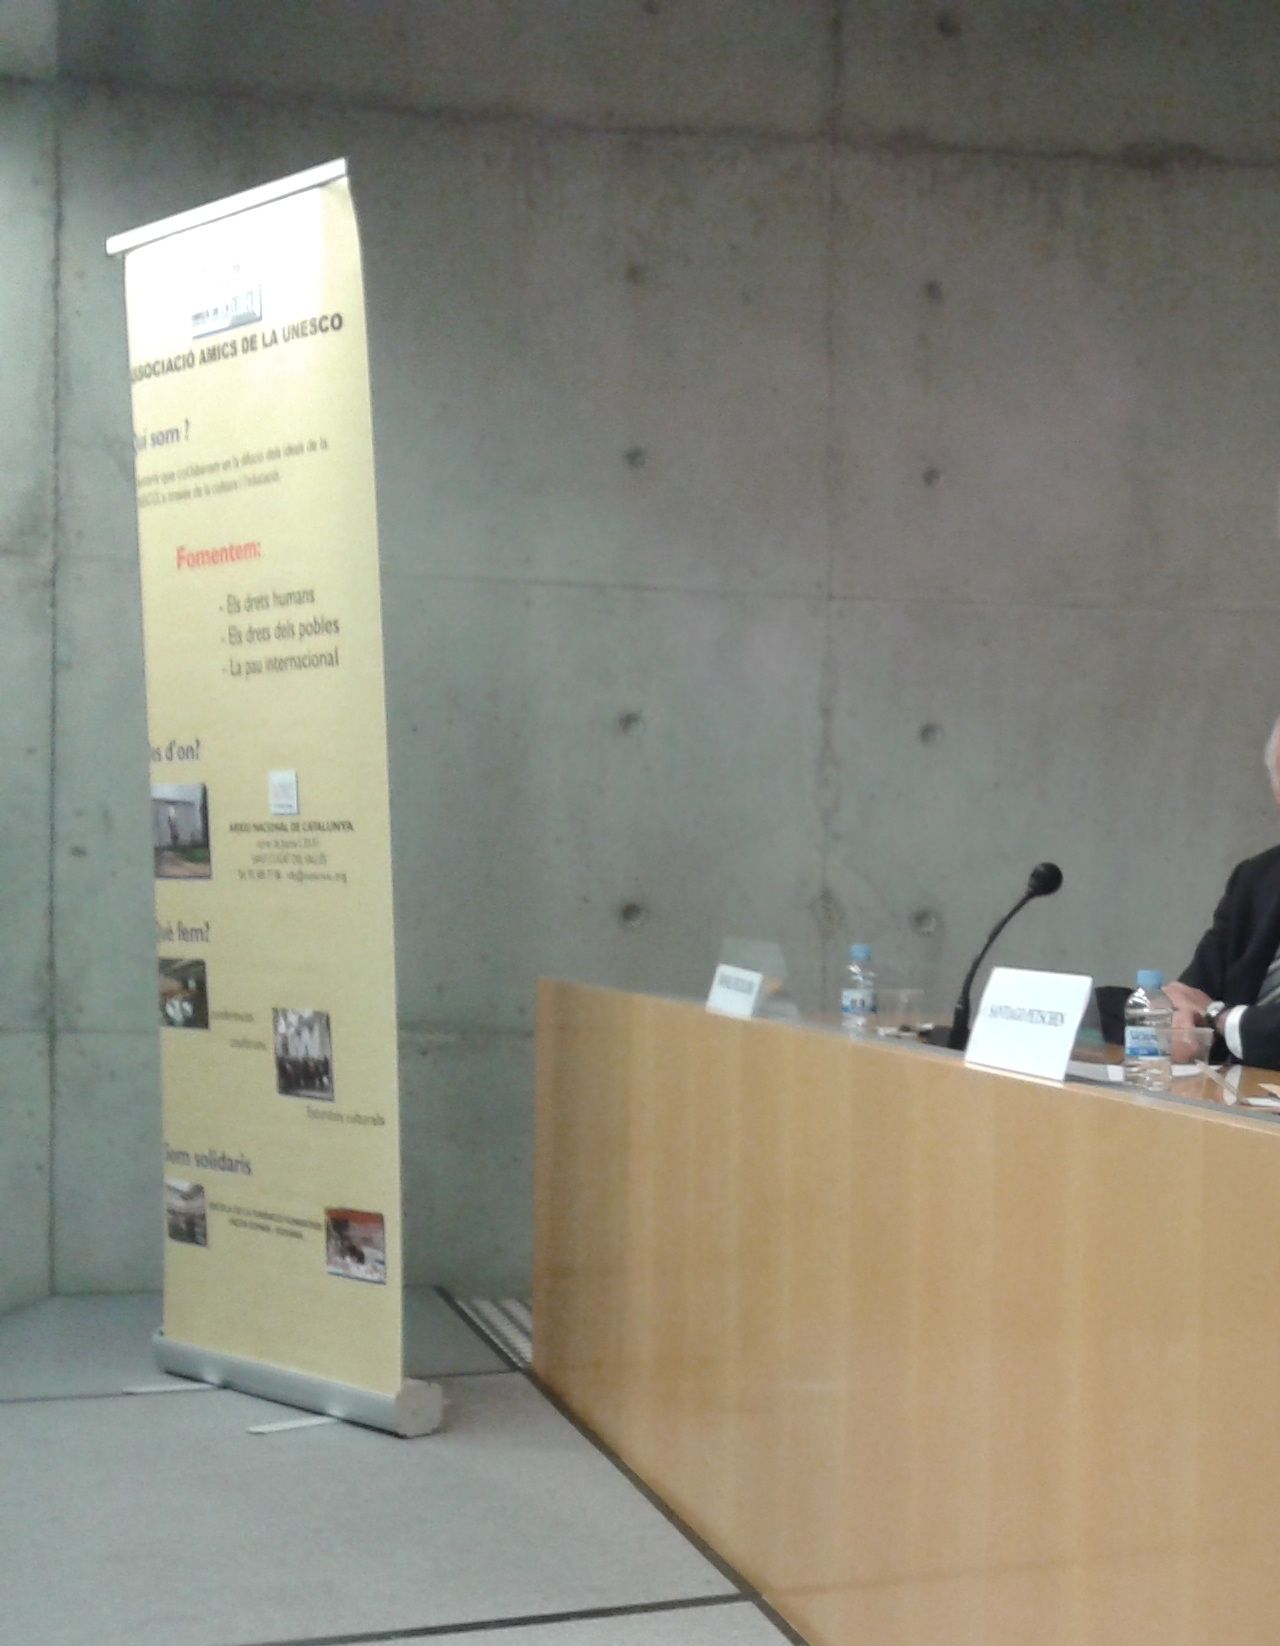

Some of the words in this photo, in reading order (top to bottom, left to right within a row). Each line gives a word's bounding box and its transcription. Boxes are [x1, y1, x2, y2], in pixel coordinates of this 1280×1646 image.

[199, 339, 238, 366] AMICS
[242, 333, 258, 355] DE
[262, 329, 278, 347] LA
[283, 312, 344, 342] UNESCO
[150, 427, 181, 448] som
[176, 540, 261, 570] Fomentem:
[244, 592, 270, 612] drets
[272, 587, 316, 607] humans
[299, 615, 341, 642] pobles
[229, 657, 242, 677] La
[245, 660, 263, 682] pau
[265, 646, 340, 673] internacional
[194, 1149, 253, 1177] solidaris
